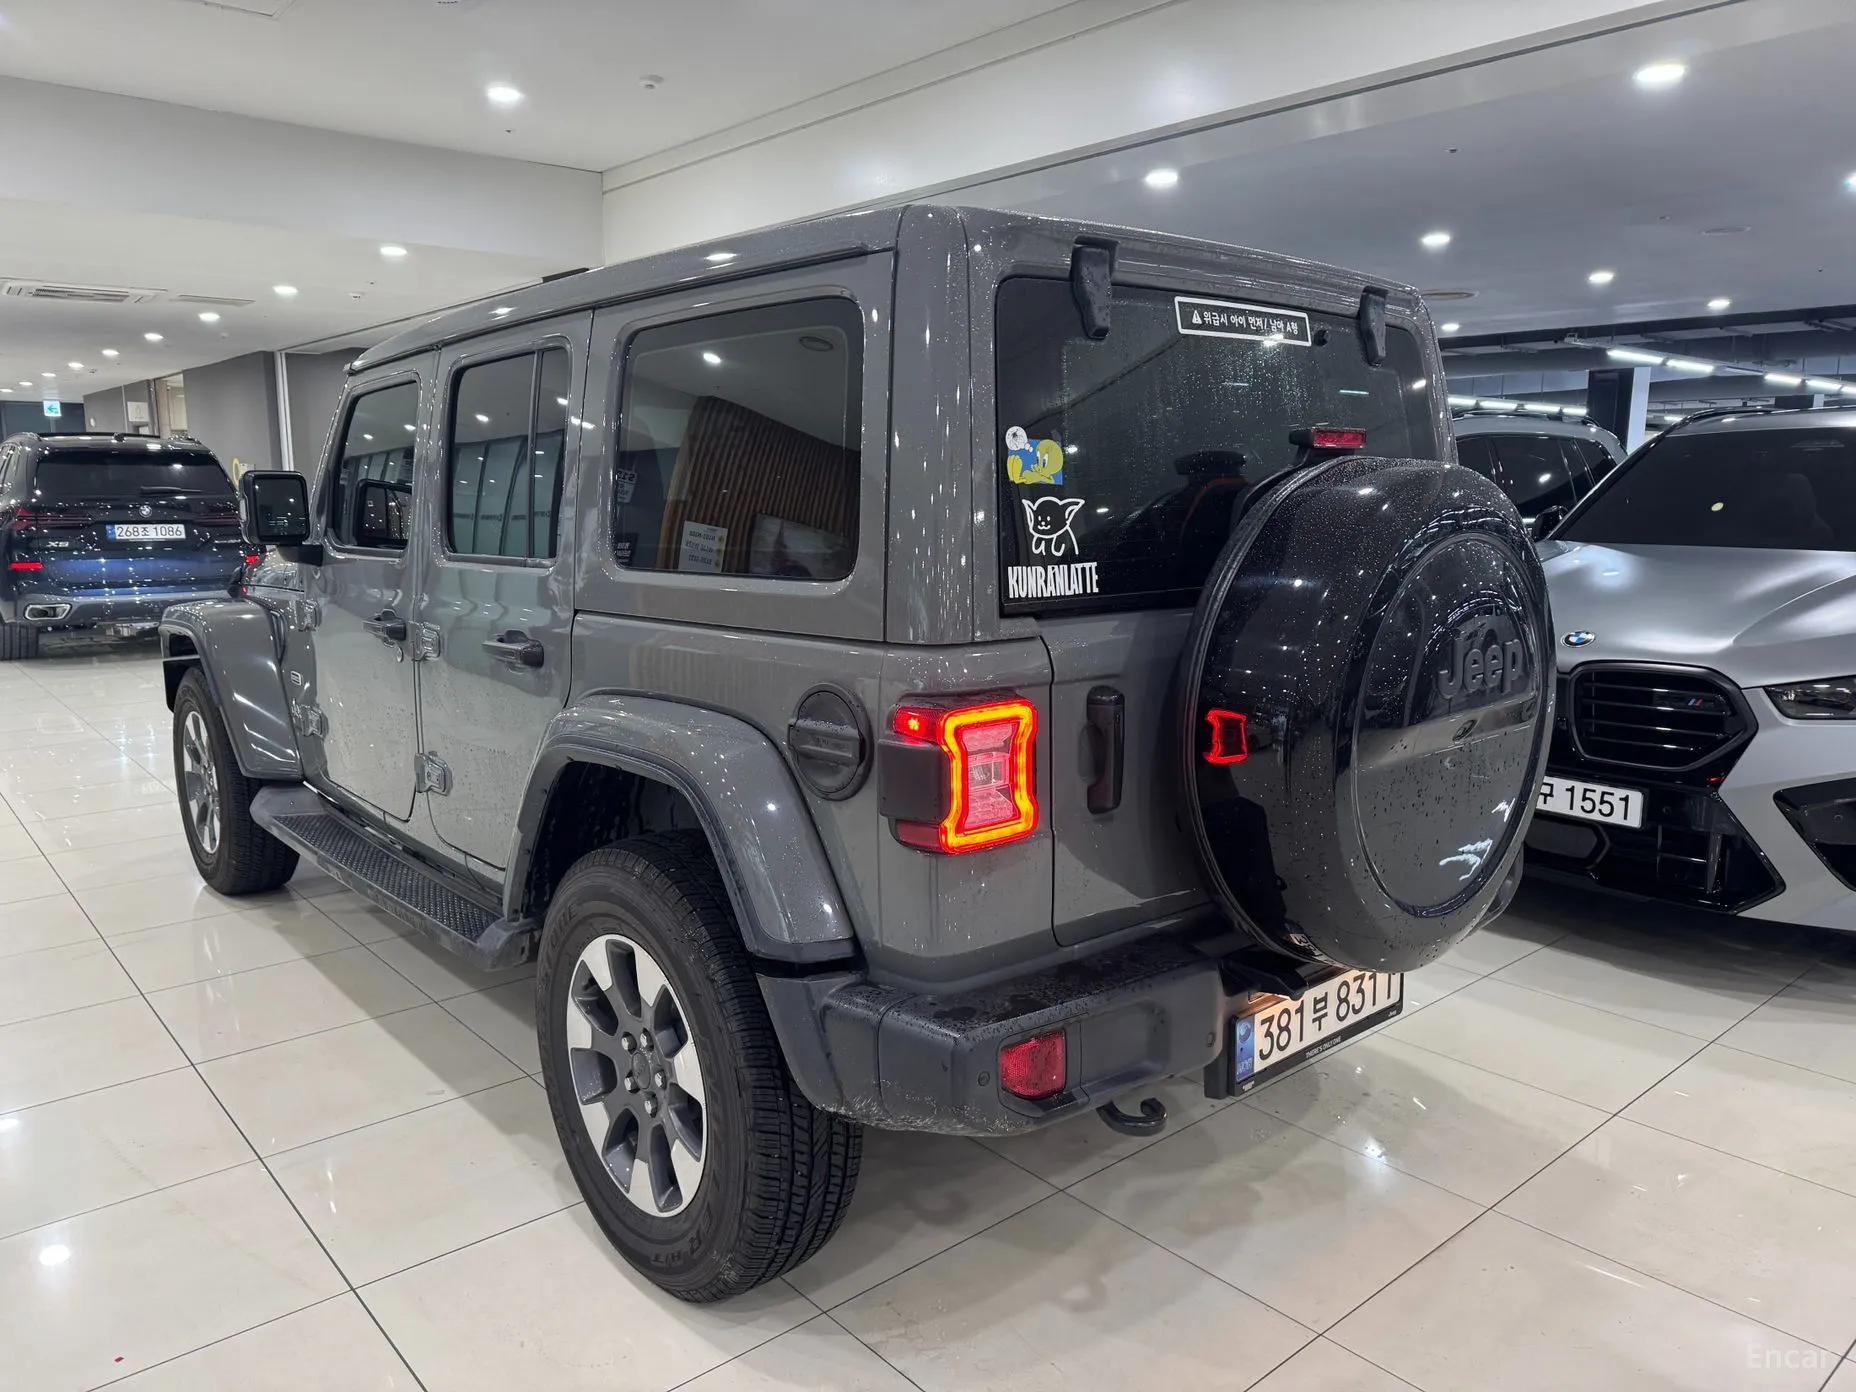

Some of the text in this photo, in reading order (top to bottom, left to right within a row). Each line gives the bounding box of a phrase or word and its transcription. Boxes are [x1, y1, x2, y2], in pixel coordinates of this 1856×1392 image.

[1203, 311, 1228, 326] 위급시
[1230, 315, 1246, 328] 아이
[153, 526, 183, 537] 1086
[1438, 638, 1523, 699] Jeep
[1565, 785, 1630, 821] 1551
[1259, 991, 1328, 1061] 381부
